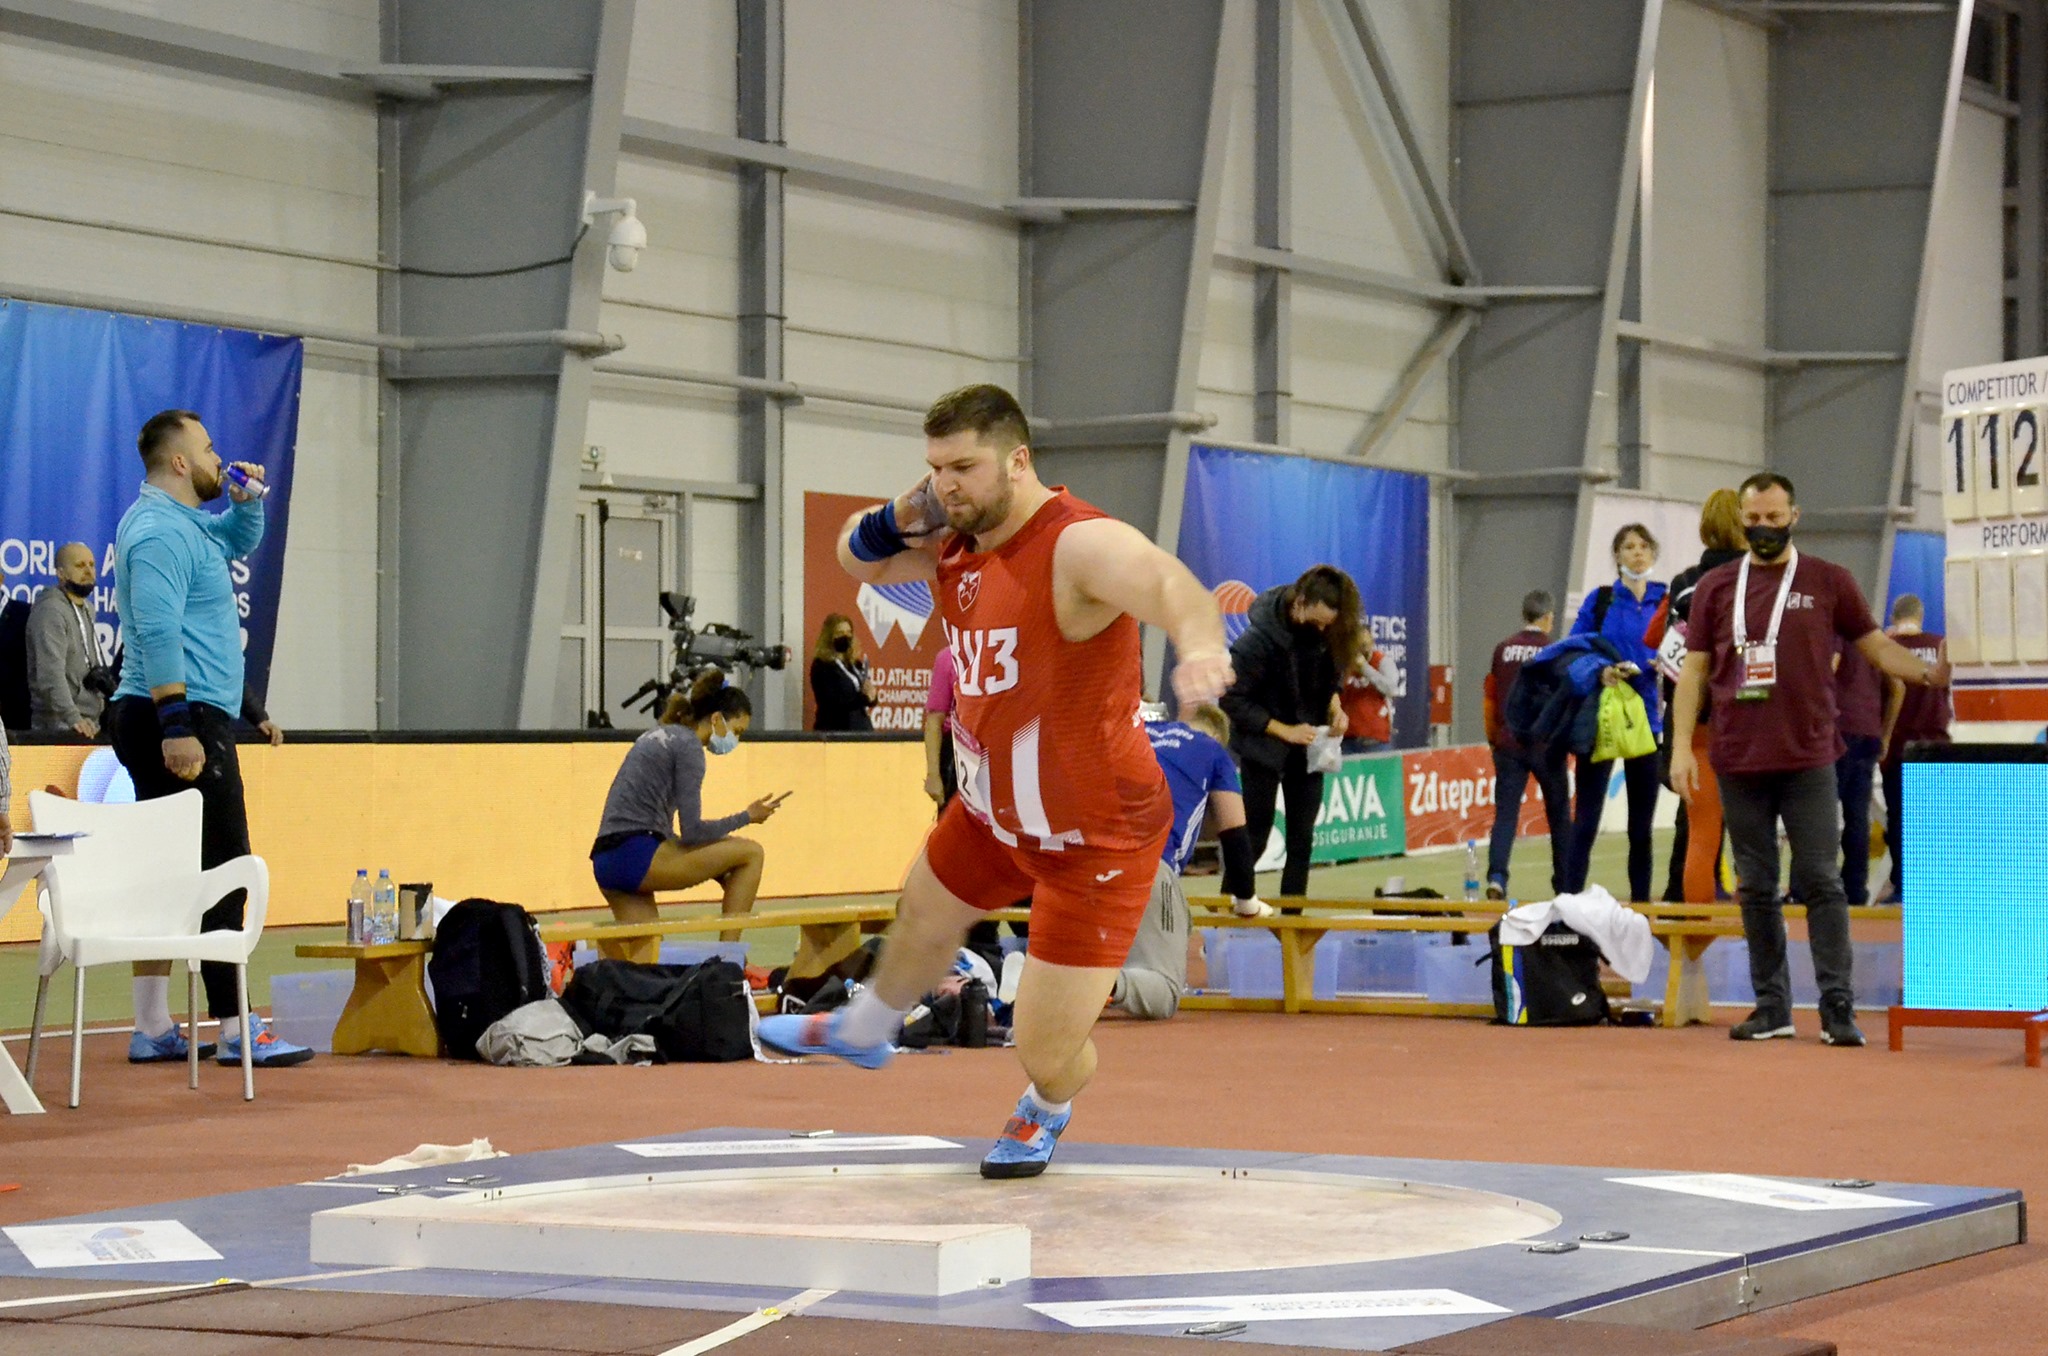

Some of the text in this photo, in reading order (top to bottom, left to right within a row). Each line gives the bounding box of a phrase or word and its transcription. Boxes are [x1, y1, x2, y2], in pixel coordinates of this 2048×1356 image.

[1947, 372, 2038, 406] COMPETITOR
[1947, 409, 2039, 493] 112
[877, 689, 929, 704] CHAMPIONS
[870, 705, 924, 729] GRADE
